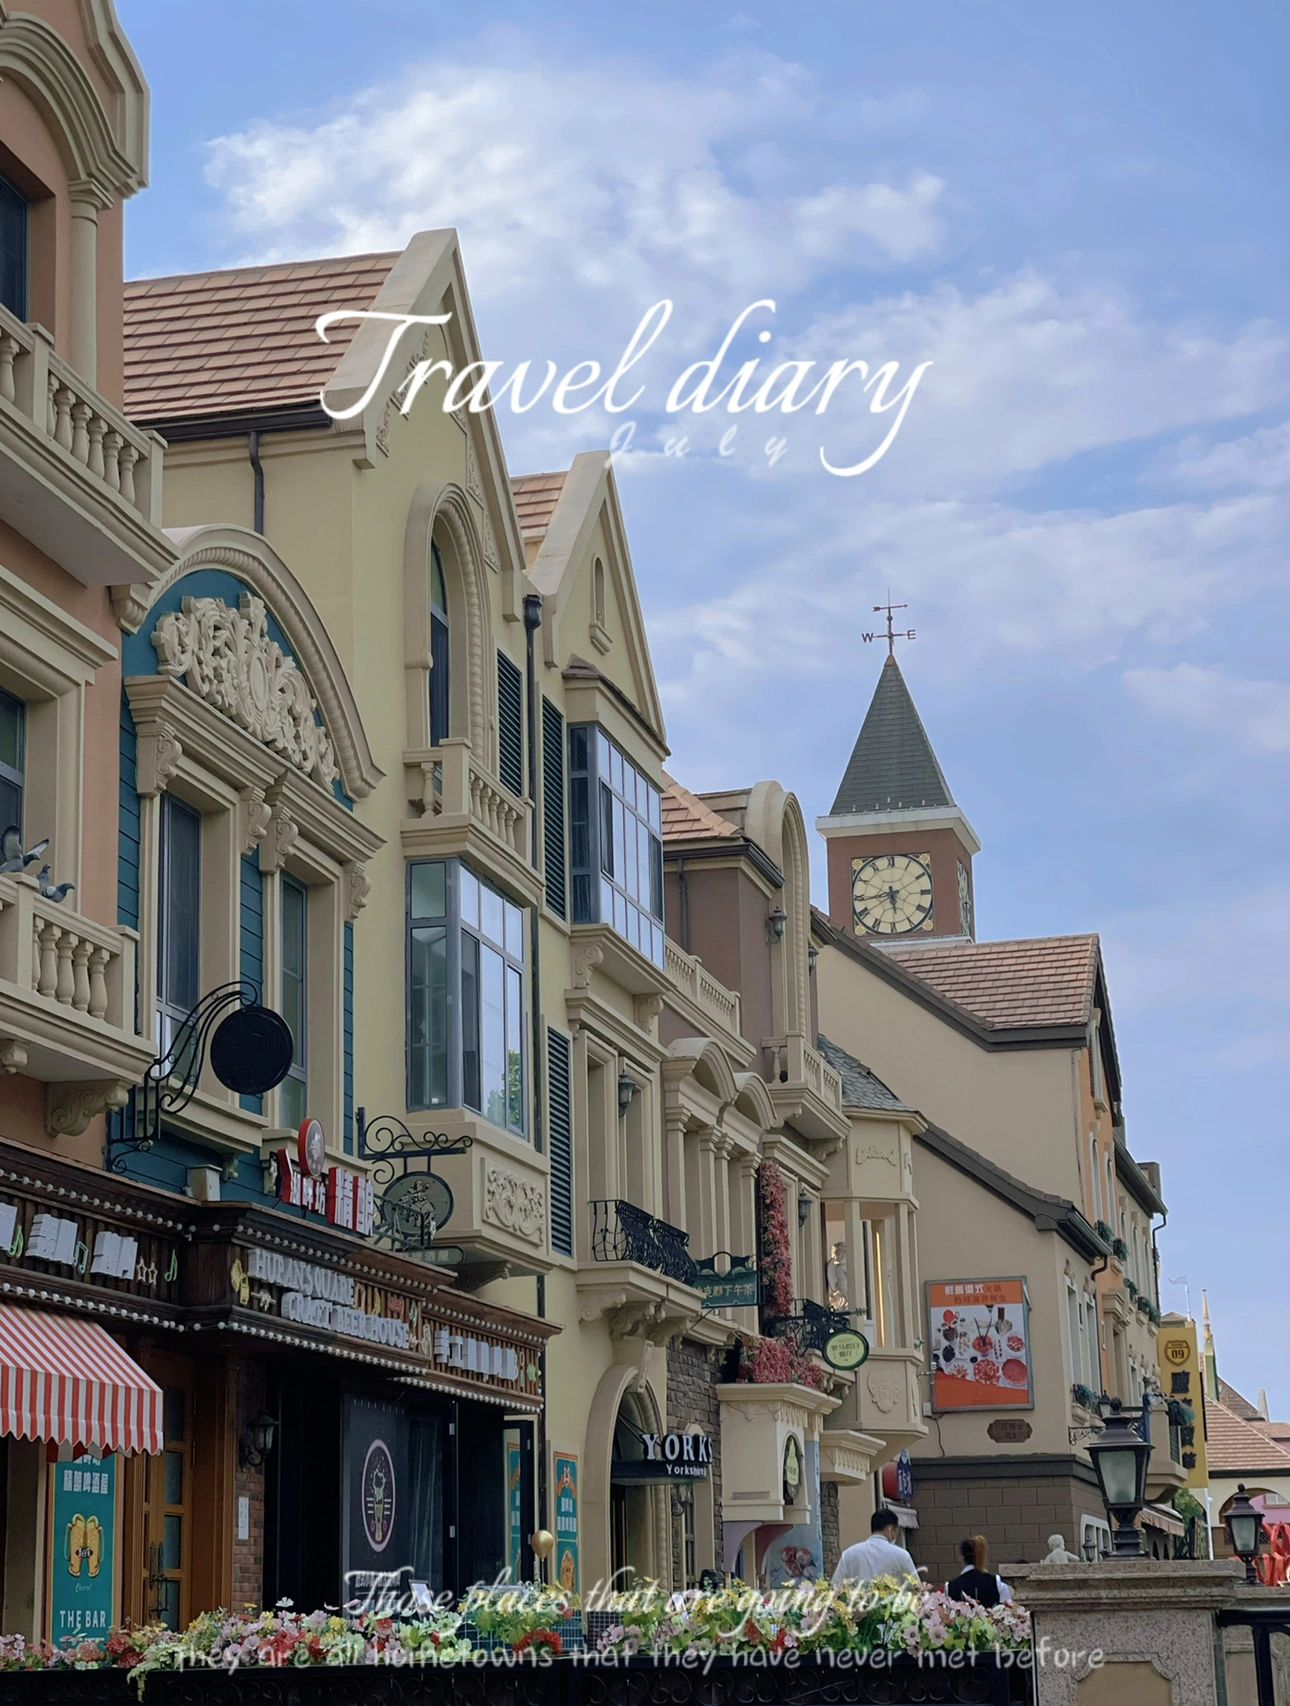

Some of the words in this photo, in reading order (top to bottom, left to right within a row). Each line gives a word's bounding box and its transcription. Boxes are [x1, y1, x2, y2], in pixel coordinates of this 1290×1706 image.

[861, 632, 874, 643] W
[907, 629, 916, 640] E
[1171, 1349, 1185, 1360] 09
[59, 1610, 82, 1628] THE
[85, 1610, 106, 1628] BAR
